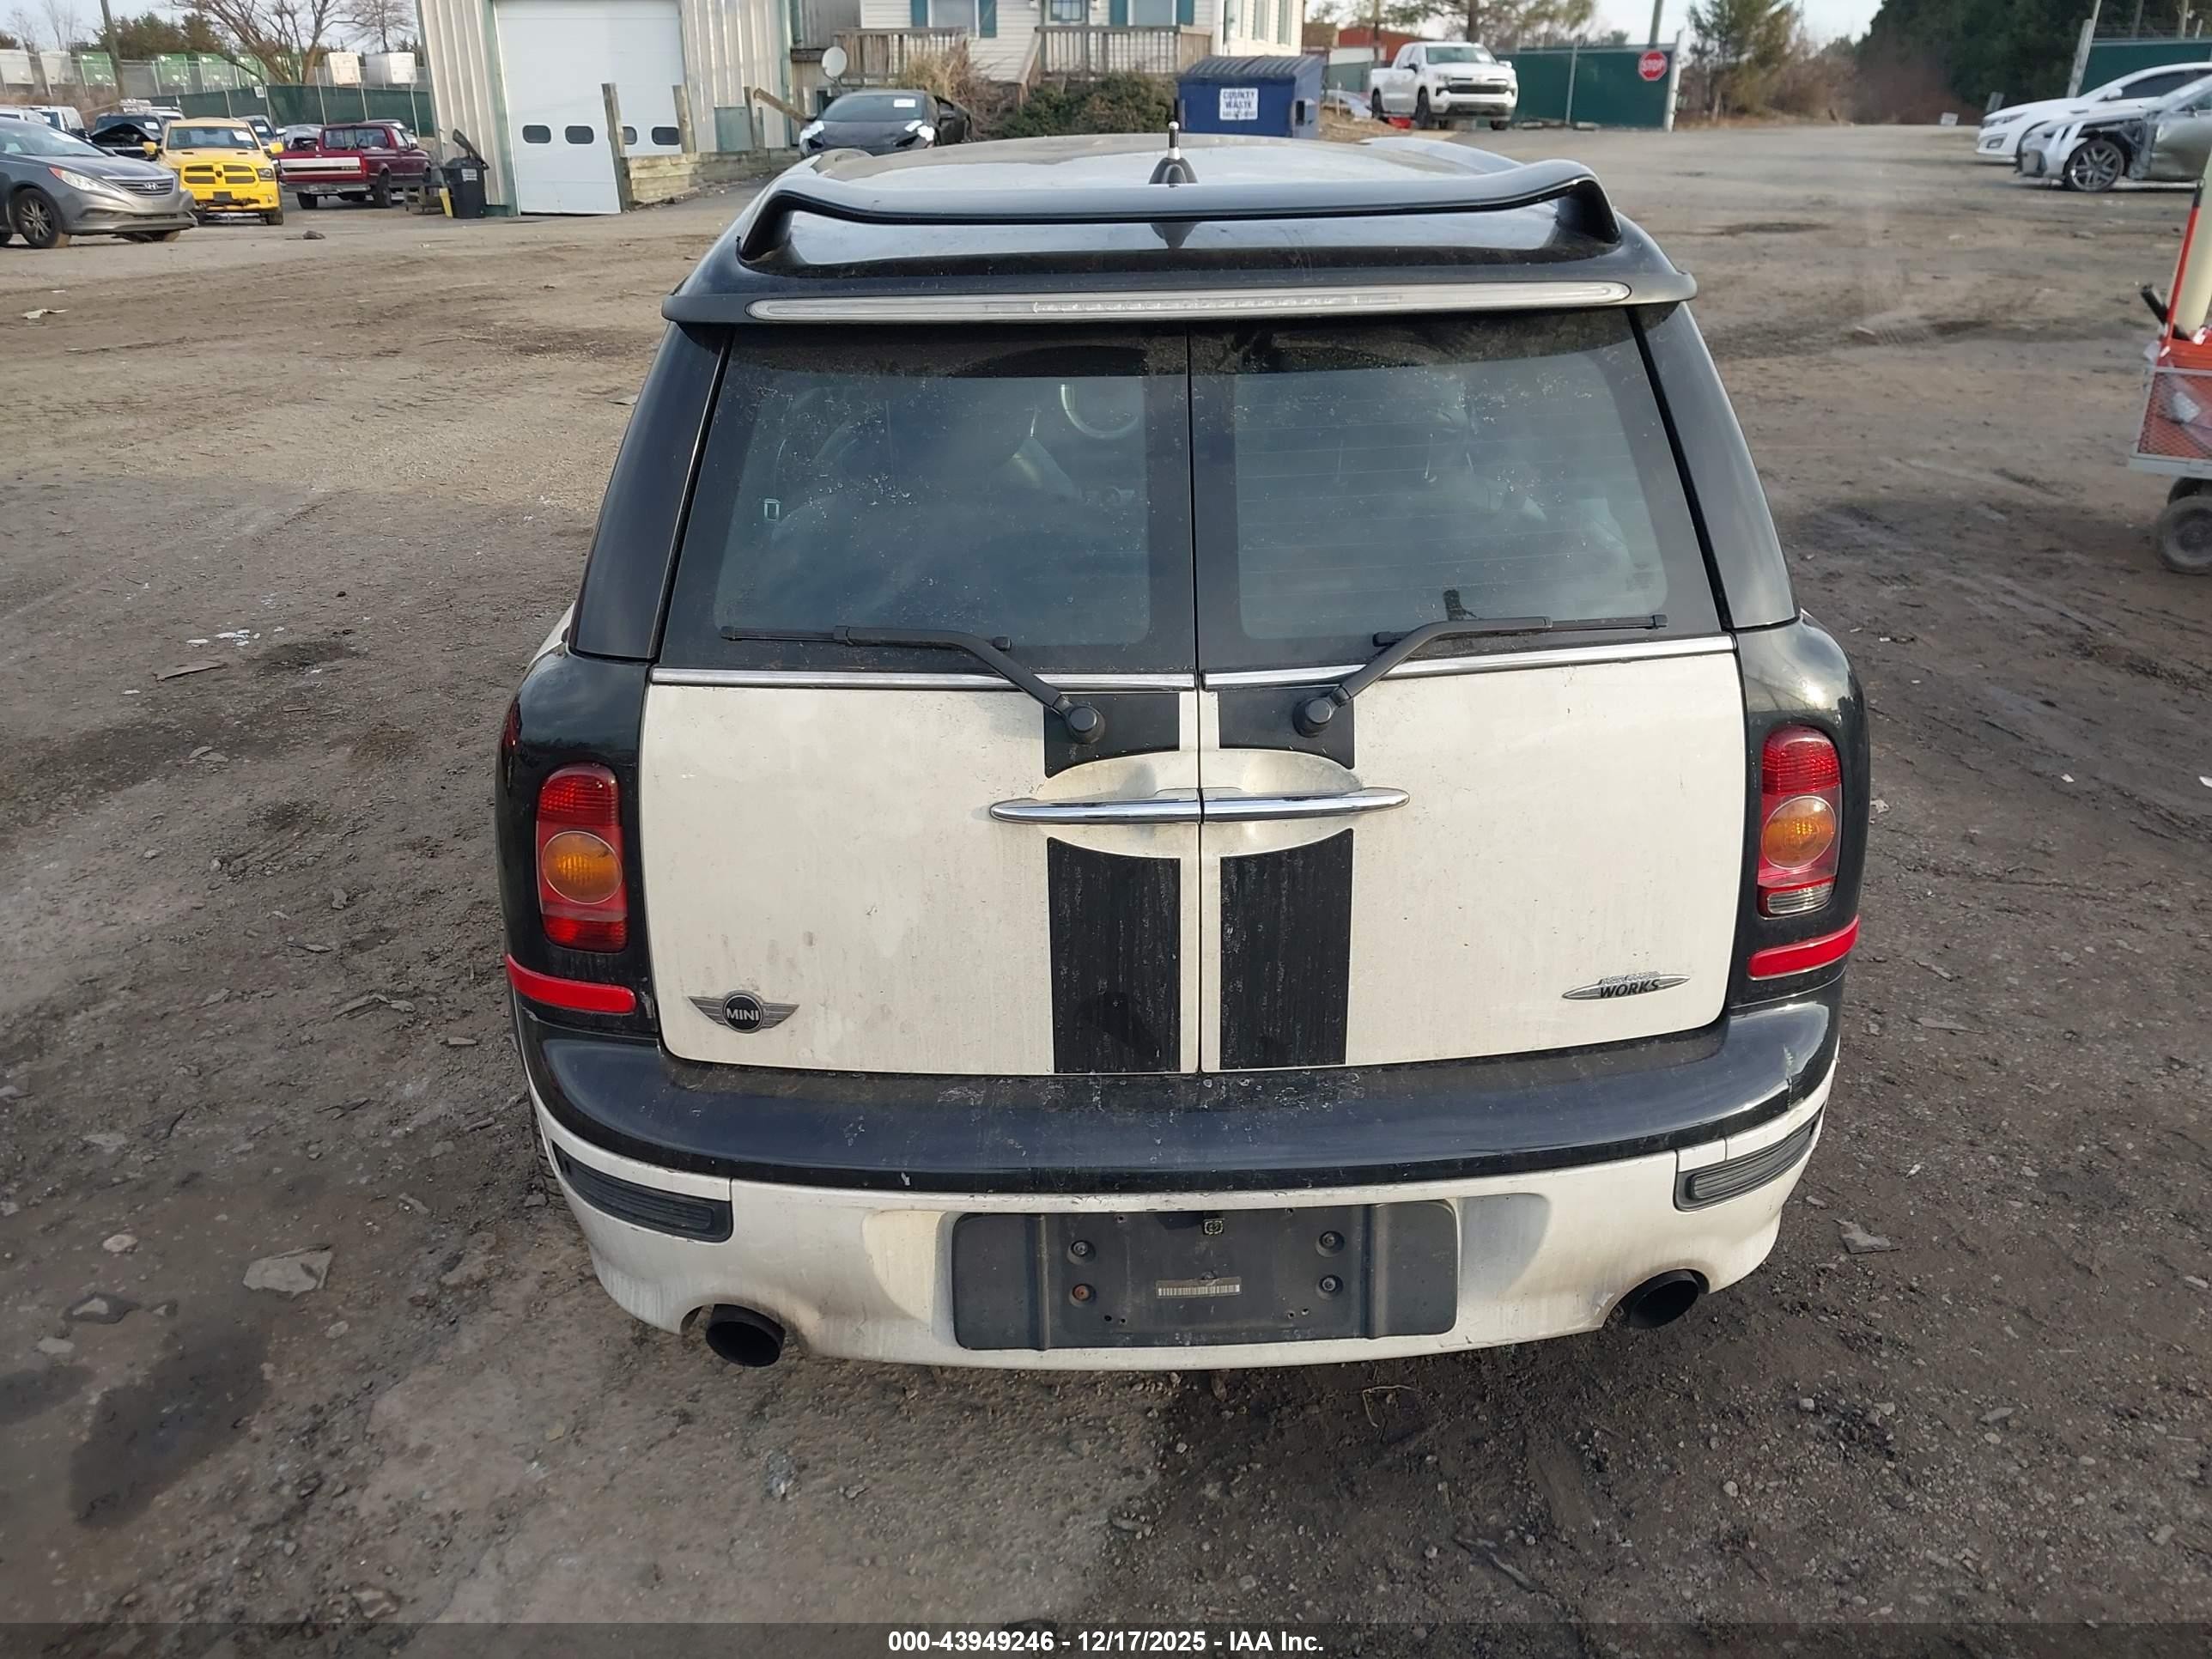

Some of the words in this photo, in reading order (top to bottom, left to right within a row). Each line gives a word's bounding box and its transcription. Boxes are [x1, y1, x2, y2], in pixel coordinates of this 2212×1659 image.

[1641, 59, 1665, 71] STOP
[1600, 979, 1661, 998] WORKS
[726, 1007, 760, 1021] MINI
